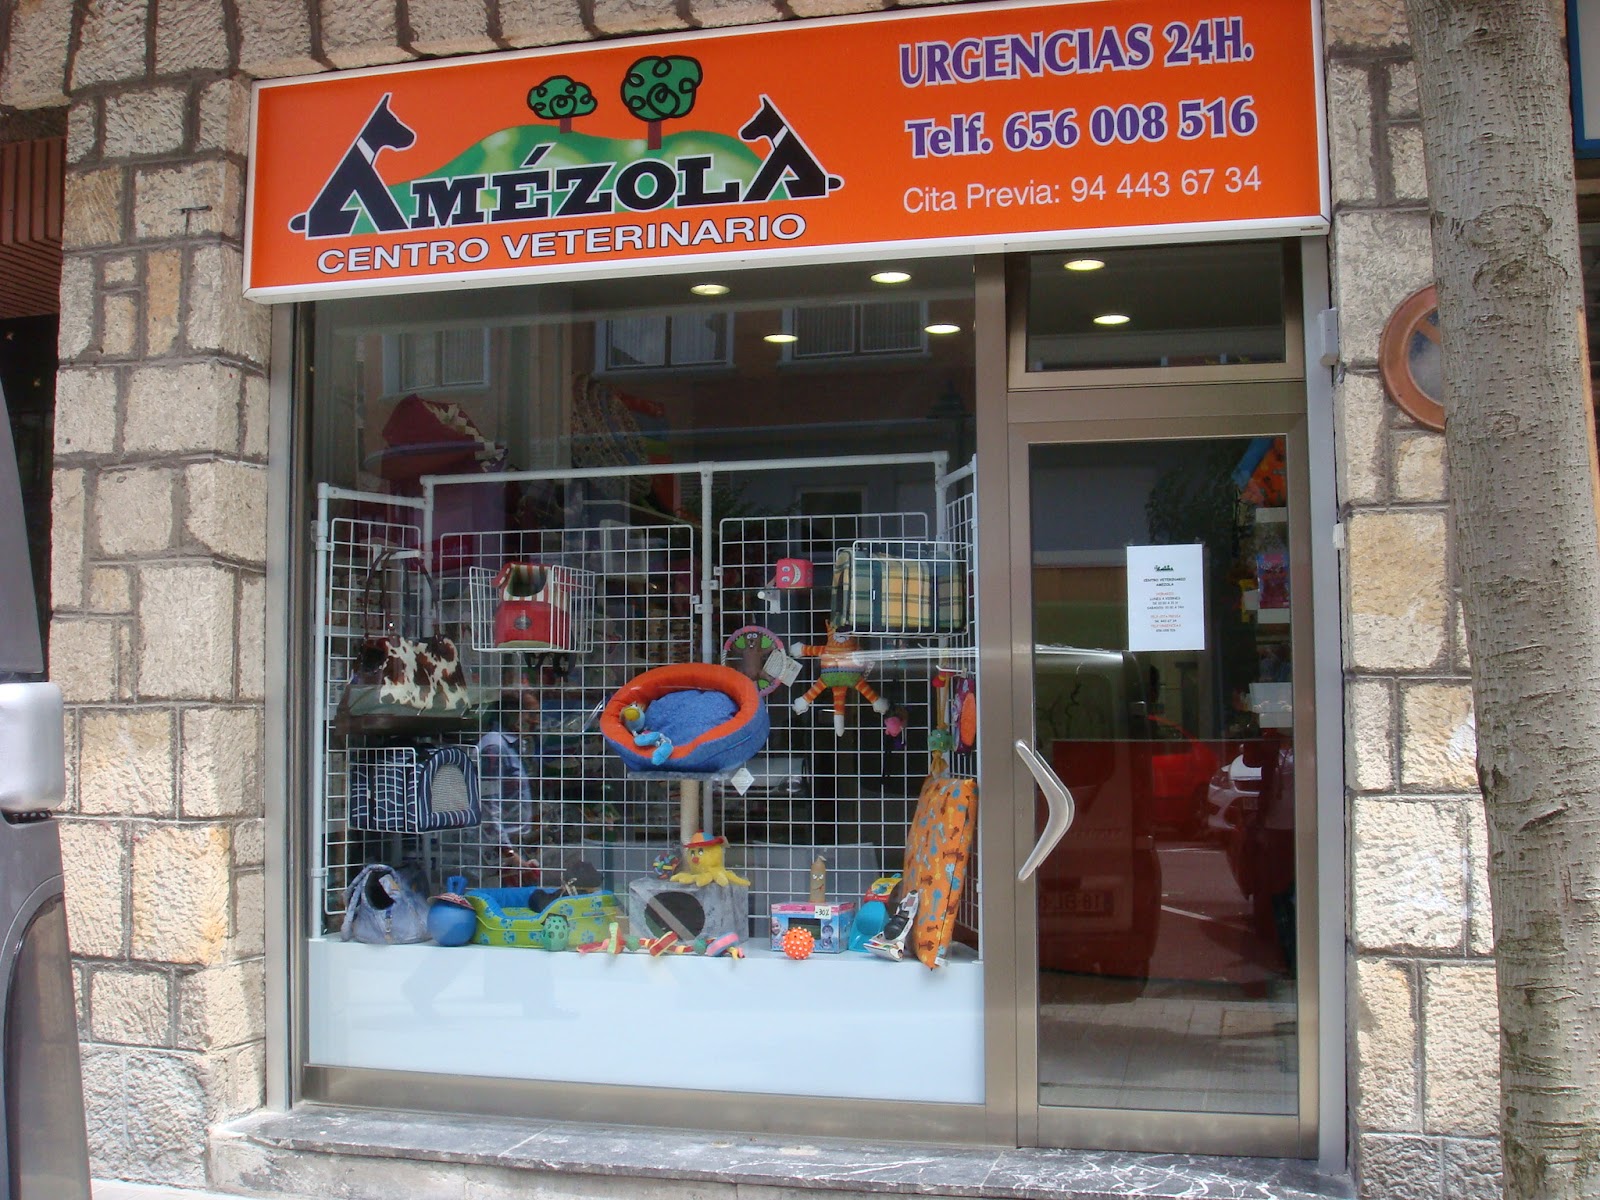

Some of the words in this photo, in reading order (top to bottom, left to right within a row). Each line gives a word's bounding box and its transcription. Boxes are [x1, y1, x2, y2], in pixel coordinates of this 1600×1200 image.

[899, 23, 1154, 87] URGENCIAS
[1164, 16, 1254, 68] 24H.
[905, 111, 993, 158] Telf.
[1003, 108, 1080, 151] 656
[1089, 103, 1168, 145] 008
[1177, 95, 1258, 140] 516
[290, 92, 844, 238] AMÉZOLA
[903, 186, 957, 213] Cita
[966, 178, 1060, 209] Previa:
[1071, 175, 1106, 202] 94
[1116, 171, 1170, 199] 443
[1181, 168, 1216, 195] 67
[1225, 165, 1262, 193] 34
[316, 238, 490, 275] CENTRO
[501, 212, 807, 260] VETERINARIO
